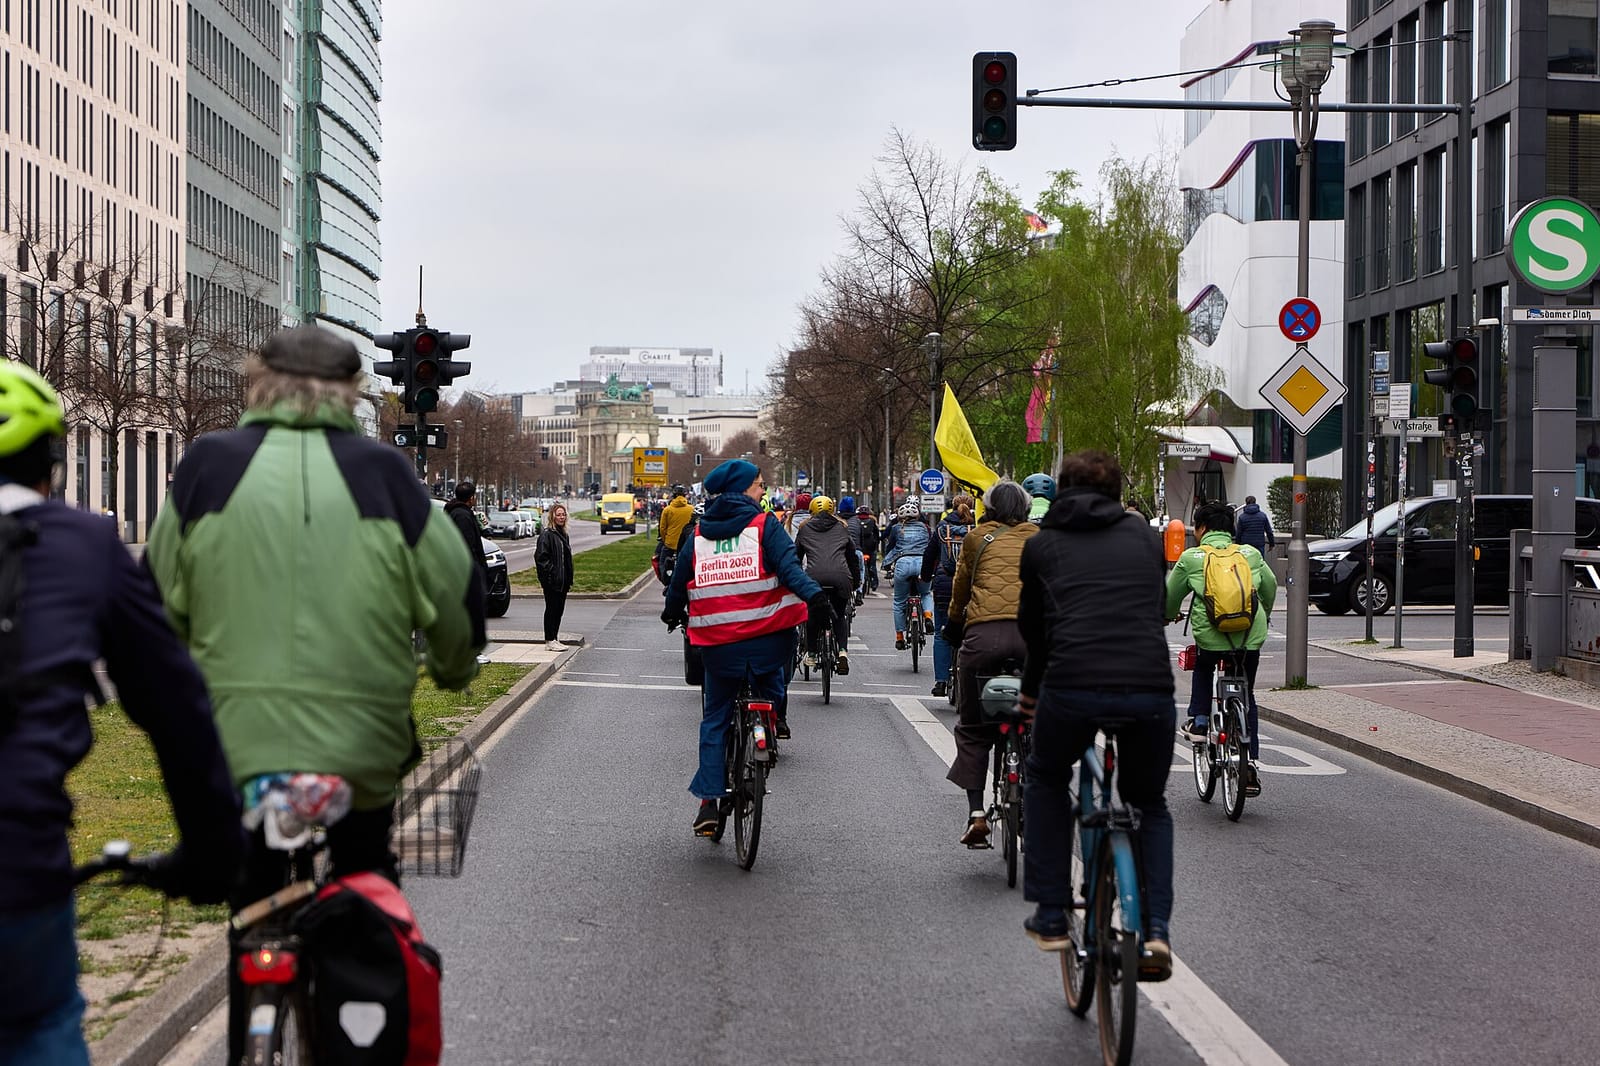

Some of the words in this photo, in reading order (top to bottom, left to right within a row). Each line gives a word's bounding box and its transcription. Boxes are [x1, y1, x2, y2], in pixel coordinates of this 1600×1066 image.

[1528, 209, 1587, 281] S
[1573, 309, 1591, 320] Platz
[701, 559, 728, 572] Berlin
[729, 556, 753, 569] 2030
[698, 567, 757, 584] Klimaneutral
